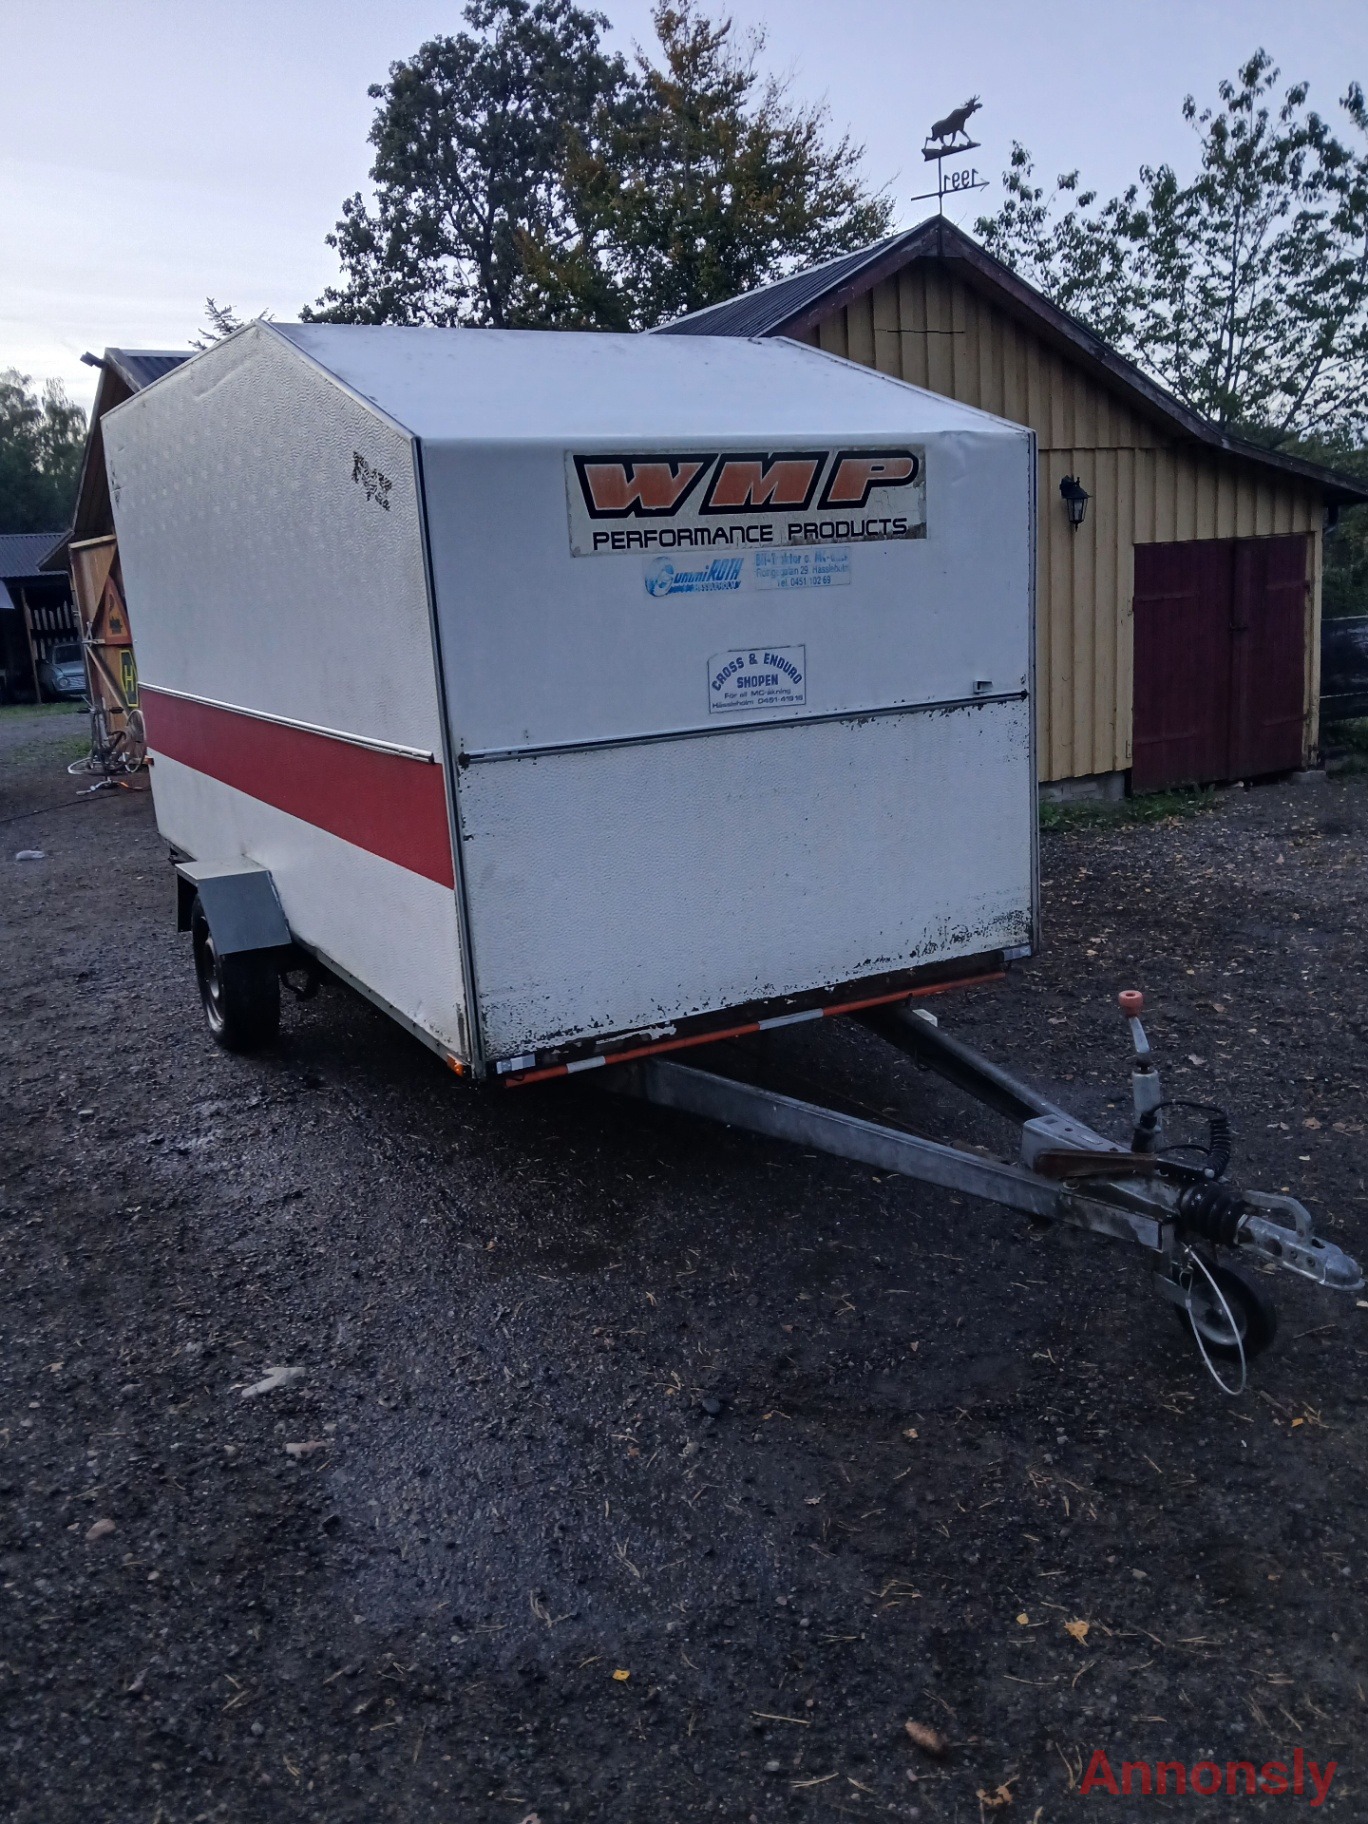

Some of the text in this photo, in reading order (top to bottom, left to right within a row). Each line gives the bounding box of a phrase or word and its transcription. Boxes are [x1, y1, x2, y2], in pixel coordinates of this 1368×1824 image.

[573, 451, 920, 519] WMP
[593, 518, 908, 550] PERFORMANCE PRODUCTS
[790, 576, 807, 586] 0451
[822, 575, 831, 584] 69
[800, 565, 808, 575] 29
[711, 652, 803, 691] CROSS & ENDURO
[736, 674, 779, 689] SHOPEN
